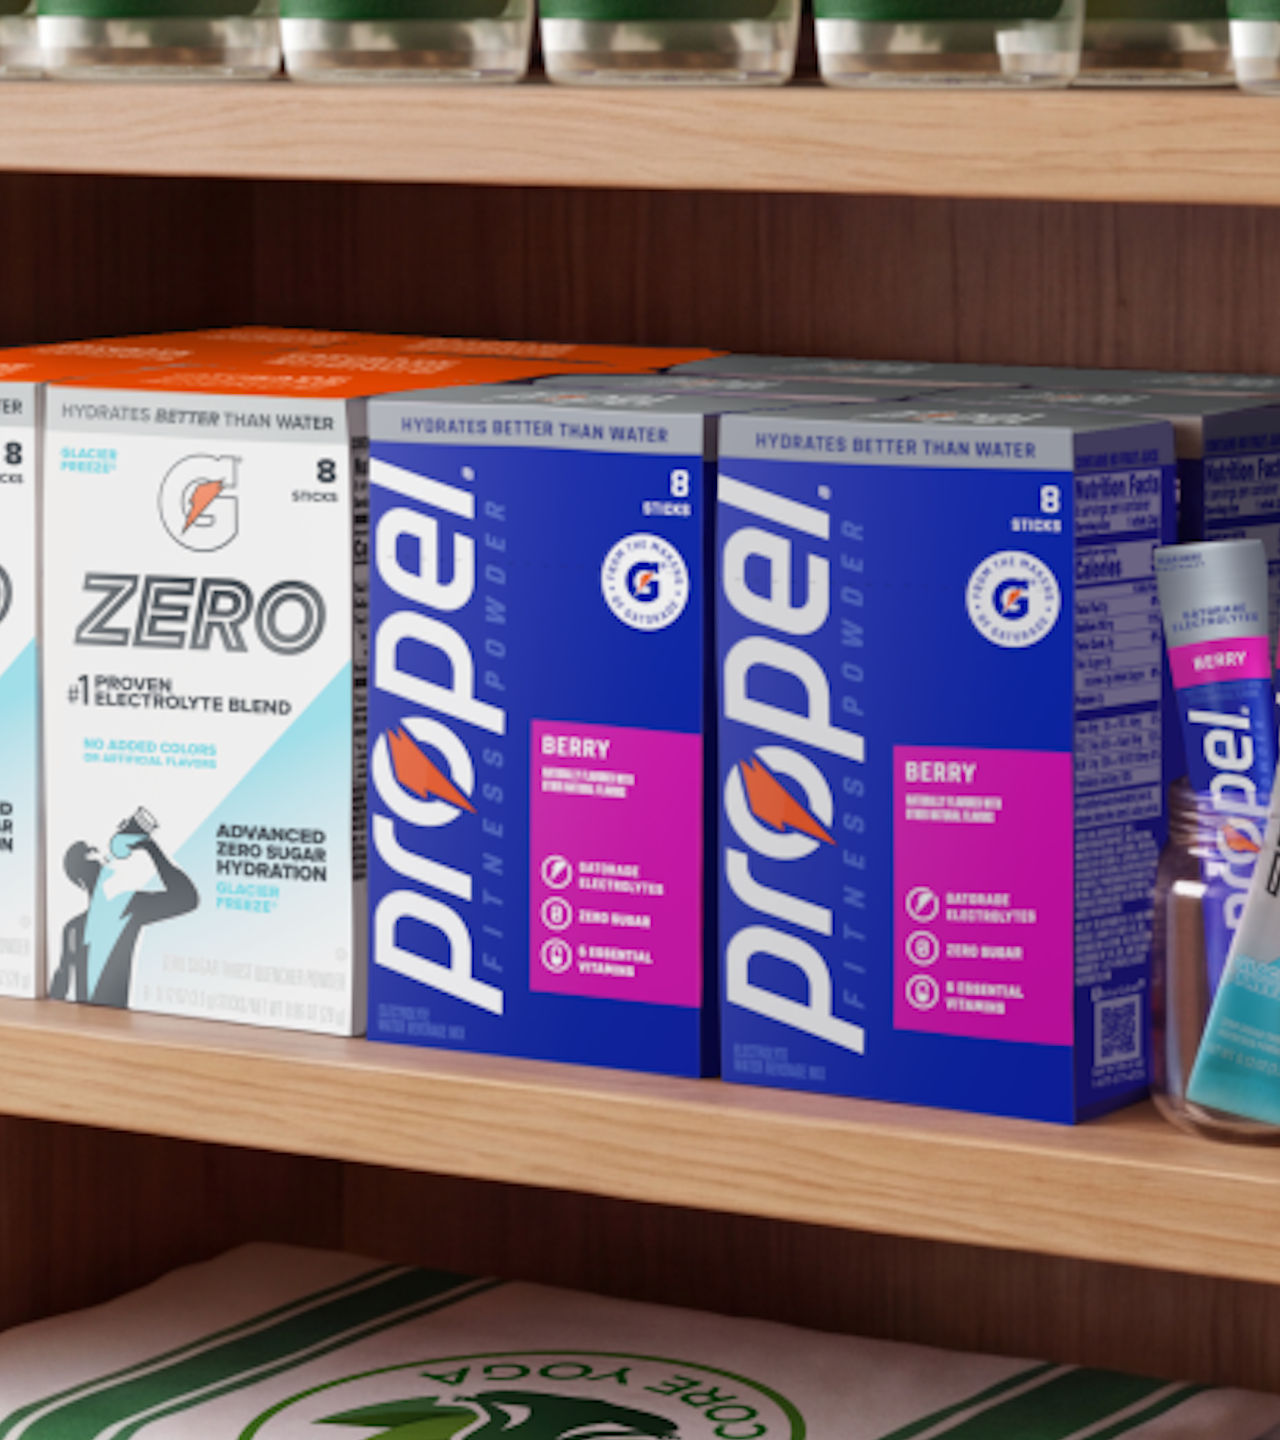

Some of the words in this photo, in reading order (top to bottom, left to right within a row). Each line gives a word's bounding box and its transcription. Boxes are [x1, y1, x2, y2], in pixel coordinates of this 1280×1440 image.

[62, 403, 150, 423] HYDRATES
[155, 408, 220, 427] BETTER
[224, 411, 271, 429] THAN
[276, 414, 334, 432] WATER
[401, 417, 487, 435] HYDRATES
[492, 420, 553, 437] BETTER
[559, 423, 604, 440] THAN
[609, 426, 669, 443] WATER
[3, 441, 24, 465] 8
[756, 432, 847, 452] HYDRATES
[852, 435, 917, 455] BETTER
[923, 438, 970, 457] THAN
[975, 440, 1036, 459] WATER
[316, 458, 337, 484] 8
[669, 469, 690, 498] 8
[291, 490, 339, 503] STICKS
[642, 500, 692, 517] STICKS
[1039, 484, 1061, 514] 8
[1011, 517, 1063, 533] STICKS
[485, 501, 506, 692] POWDER
[74, 572, 327, 655] ZERO
[840, 520, 864, 717] POWDER
[1193, 651, 1247, 671] BERRY
[94, 674, 172, 693] PROVEN
[94, 692, 223, 714] ELECTROLYTE
[228, 698, 292, 716] BLEND
[541, 735, 611, 760] BERRY
[905, 761, 977, 783] BERRY
[216, 823, 326, 845] ADVANCED
[216, 841, 262, 858] ZERO
[266, 844, 327, 863] SUGAR
[482, 747, 504, 973] FITNESS
[216, 859, 327, 882] HYDRATION
[843, 776, 866, 1012] FITNESS
[588, 946, 654, 964] ESSENTIAL
[421, 1362, 633, 1386] YOGA
[644, 1374, 769, 1440] CORE
